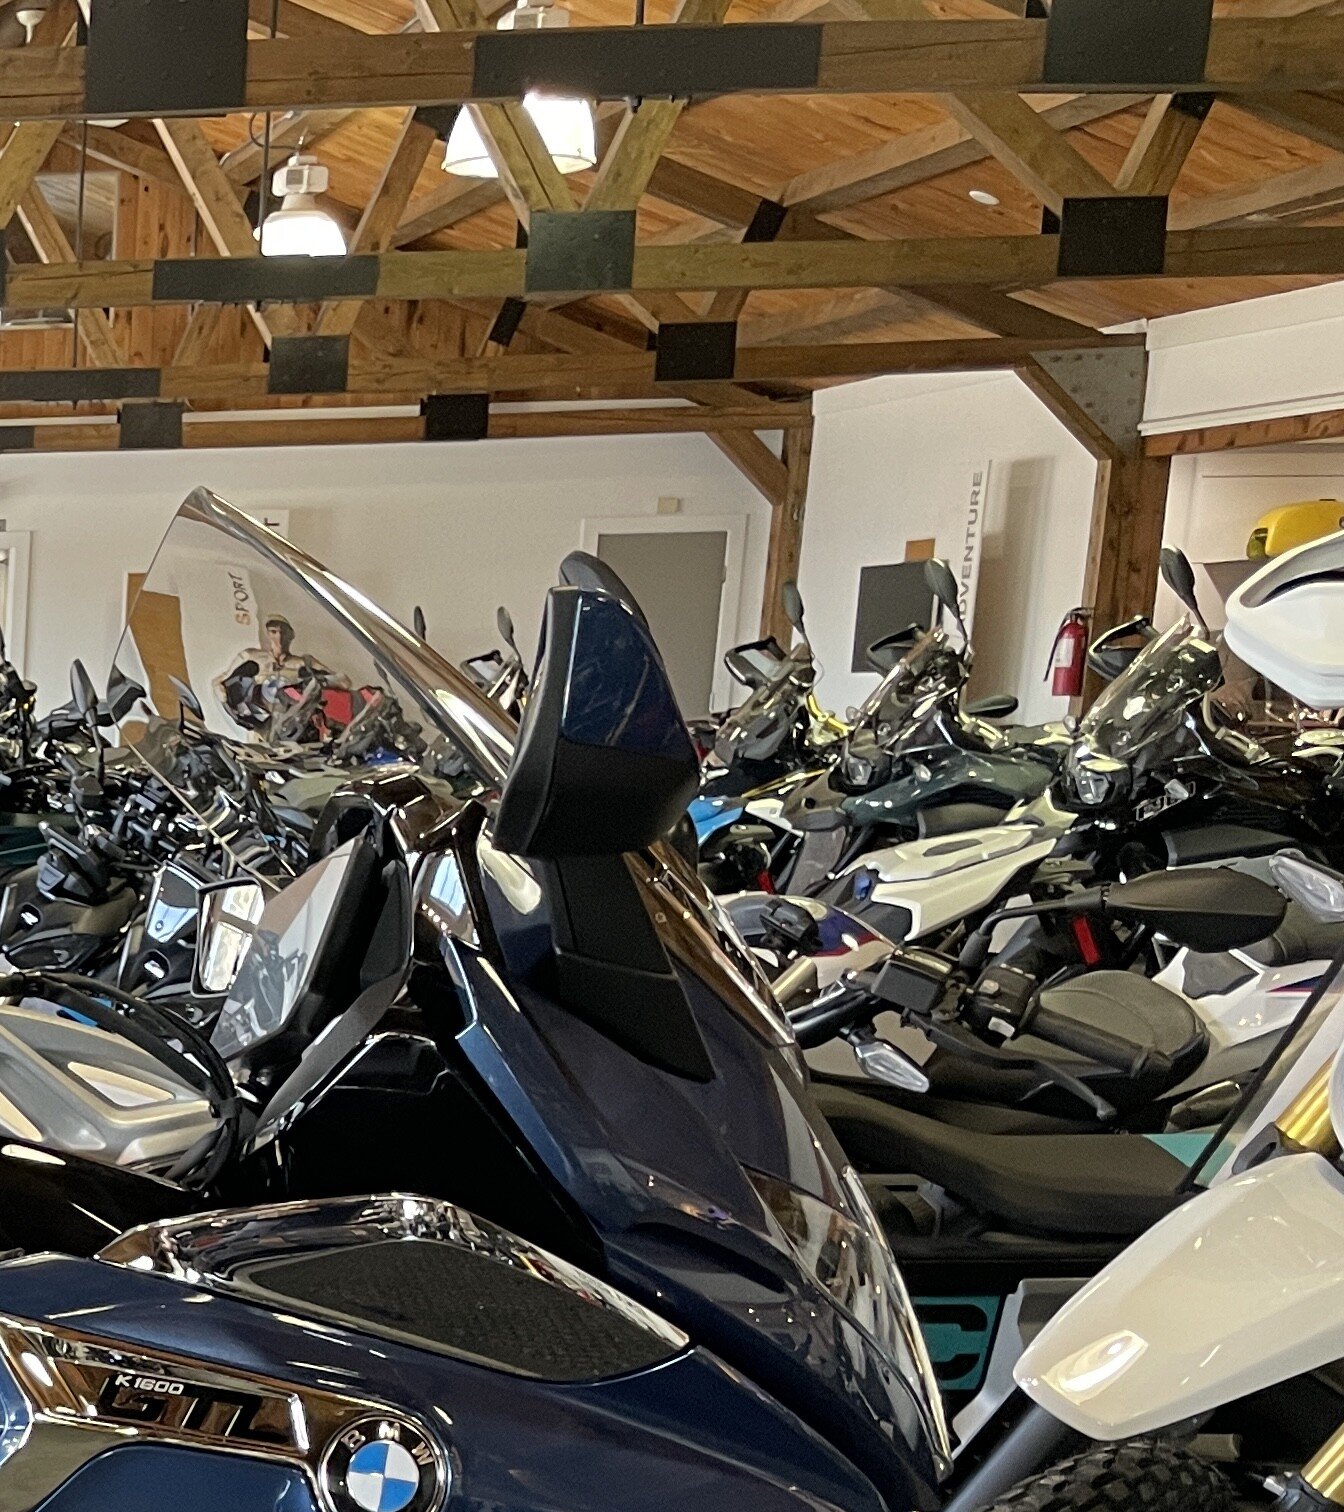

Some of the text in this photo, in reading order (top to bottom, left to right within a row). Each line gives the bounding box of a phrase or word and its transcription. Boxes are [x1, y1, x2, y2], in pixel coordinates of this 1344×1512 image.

[958, 471, 983, 621] DVENTURE
[227, 571, 251, 626] SPORT
[134, 1376, 185, 1396] 1600
[340, 1420, 434, 1466] BMW
